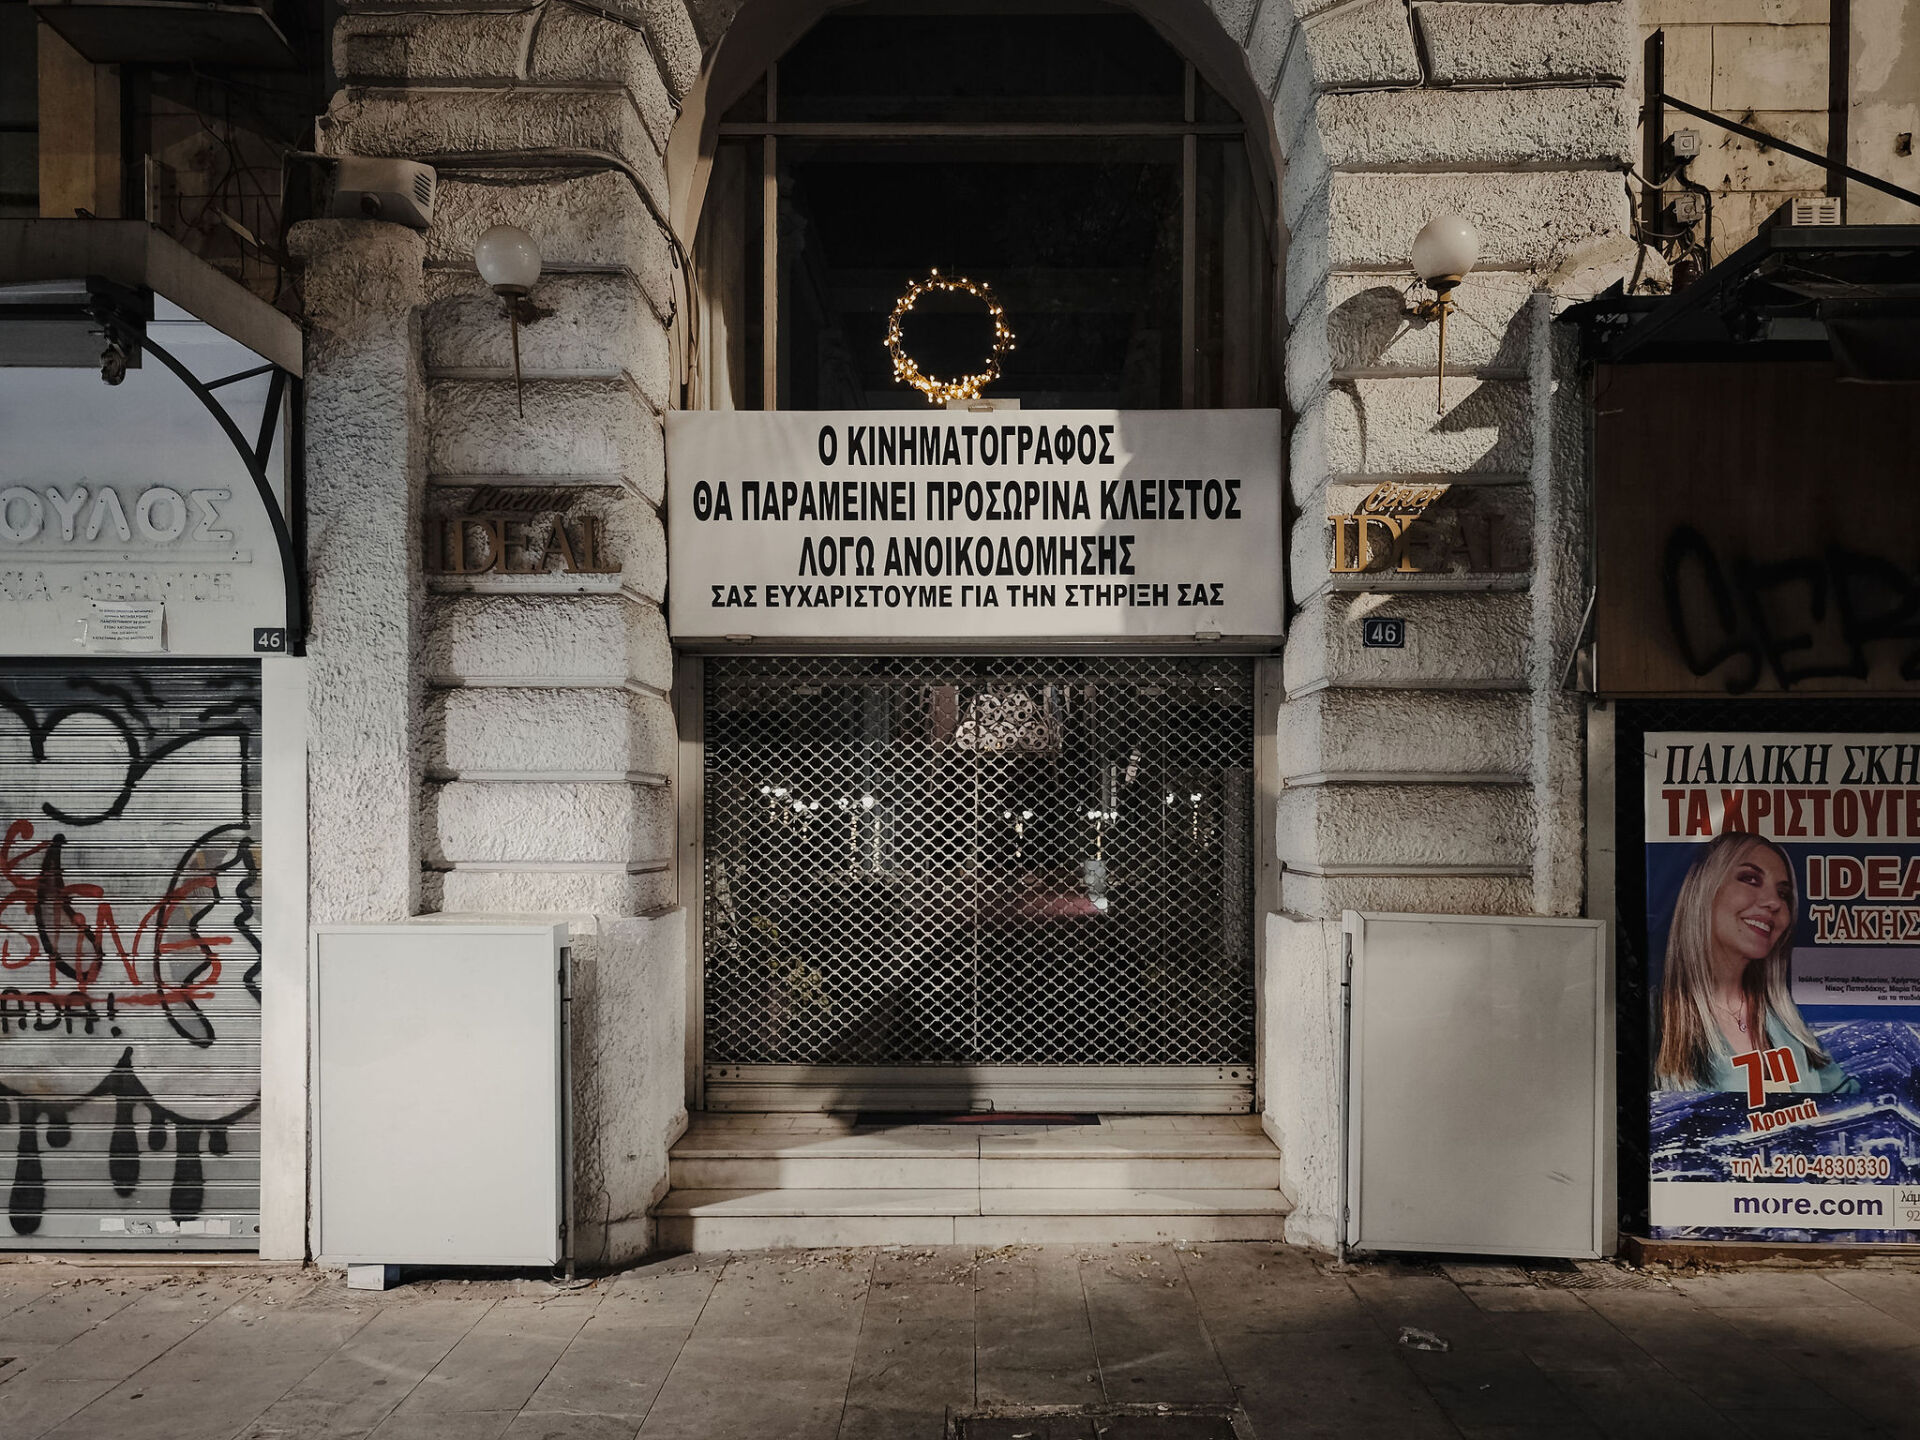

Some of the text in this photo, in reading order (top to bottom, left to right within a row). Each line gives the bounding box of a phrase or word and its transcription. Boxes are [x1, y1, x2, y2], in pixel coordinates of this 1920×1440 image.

[819, 425, 1115, 466] Ο ΚΙΝΗΜΑΤΟΓΡΑΦΟΣ
[694, 479, 1242, 521] ΘΑ ΠΑΡΑΜΕΙΝΕΙ ΠΡΟΣΩΡΙΝΑ ΚΛΕΙΣΤΟΣ
[1364, 481, 1462, 512] Cine
[422, 516, 623, 574] IDEAL
[799, 535, 1136, 577] ΛΟΓΩ ΑΝΟΙΚΟΔΟΜΗΣΗΣ
[1328, 515, 1531, 573] IDEAL
[712, 583, 1224, 608] ΣΑΣ ΕΥΧΑΡΙΣΤΟΥΜΕ ΓΙΑ ΤΗΝ ΣΤΗΡΙΞΗ ΣΑΣ
[258, 632, 280, 648] 46
[1372, 623, 1396, 642] 46
[1663, 742, 1833, 785] ΠΑΙΔΙΚΗ
[1662, 789, 1713, 837] ΤΑ
[1732, 1048, 1800, 1108] 7η
[1731, 1156, 1889, 1180] τηλ. 210-4830330
[1733, 1197, 1883, 1216] more.com
